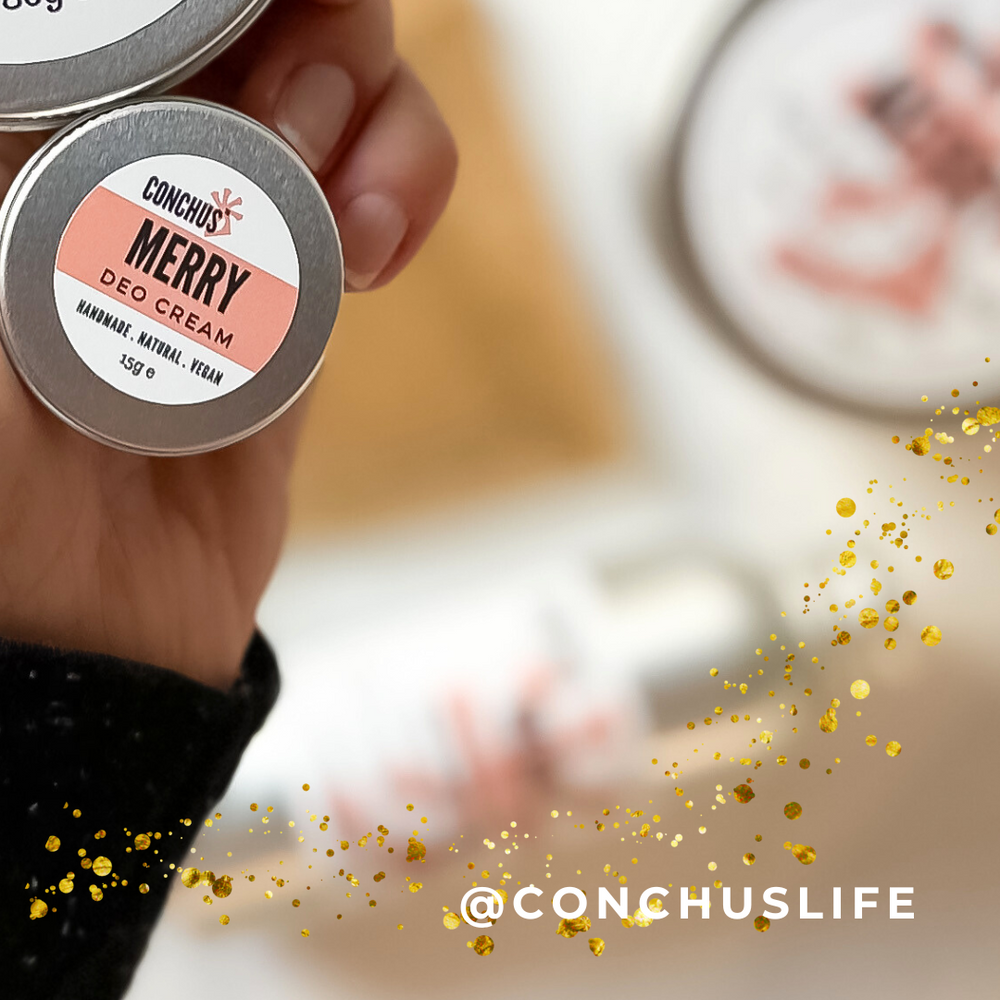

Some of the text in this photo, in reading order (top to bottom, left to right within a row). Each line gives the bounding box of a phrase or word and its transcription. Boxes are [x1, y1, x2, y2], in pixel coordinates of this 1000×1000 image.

[142, 175, 223, 234] CONCHUS
[124, 218, 252, 314] MERRY
[76, 298, 132, 338] HANDMADE
[137, 331, 182, 364] NATURAL
[190, 358, 224, 386] VEGAN
[100, 268, 234, 349] DEO CREAM
